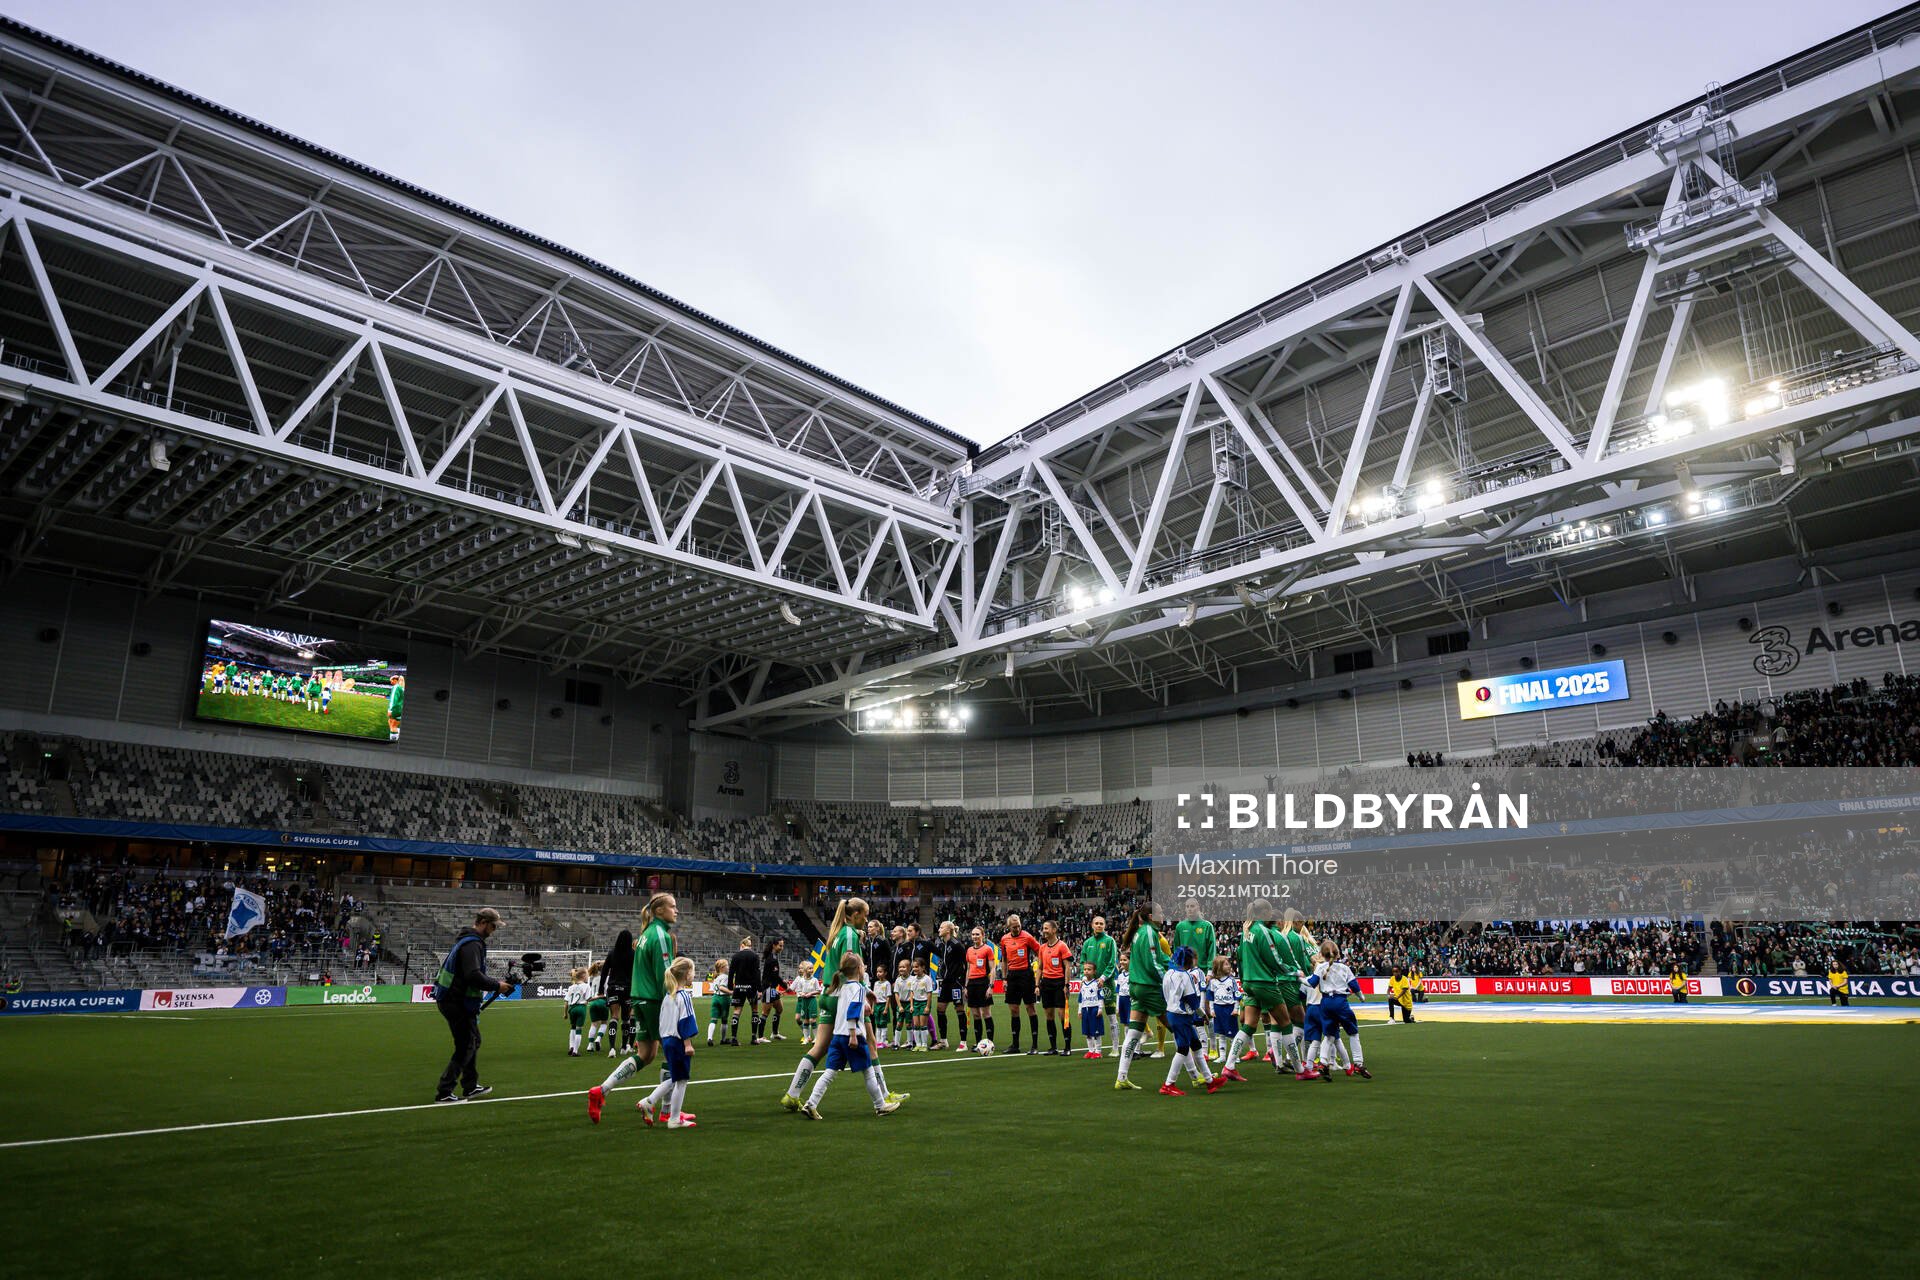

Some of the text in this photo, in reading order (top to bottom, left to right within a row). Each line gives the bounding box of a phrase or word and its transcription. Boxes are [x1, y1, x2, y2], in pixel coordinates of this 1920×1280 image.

[1806, 620, 1920, 655] Arena
[1501, 672, 1610, 705] FINAL 2025
[717, 785, 744, 796] Arena
[1839, 801, 1866, 811] FINAL
[1866, 798, 1911, 809] SVENSKA
[294, 836, 359, 846] SVENSKA CUPEN
[536, 851, 595, 862] FINAL SVENSKA CUPEN
[1495, 980, 1572, 992] BAUHAUS
[1613, 981, 1699, 992] BAUHAS
[1768, 980, 1885, 995] SVENKA
[13, 997, 124, 1008] SVENSKA CUPEN
[175, 993, 214, 1001] SVENSKA
